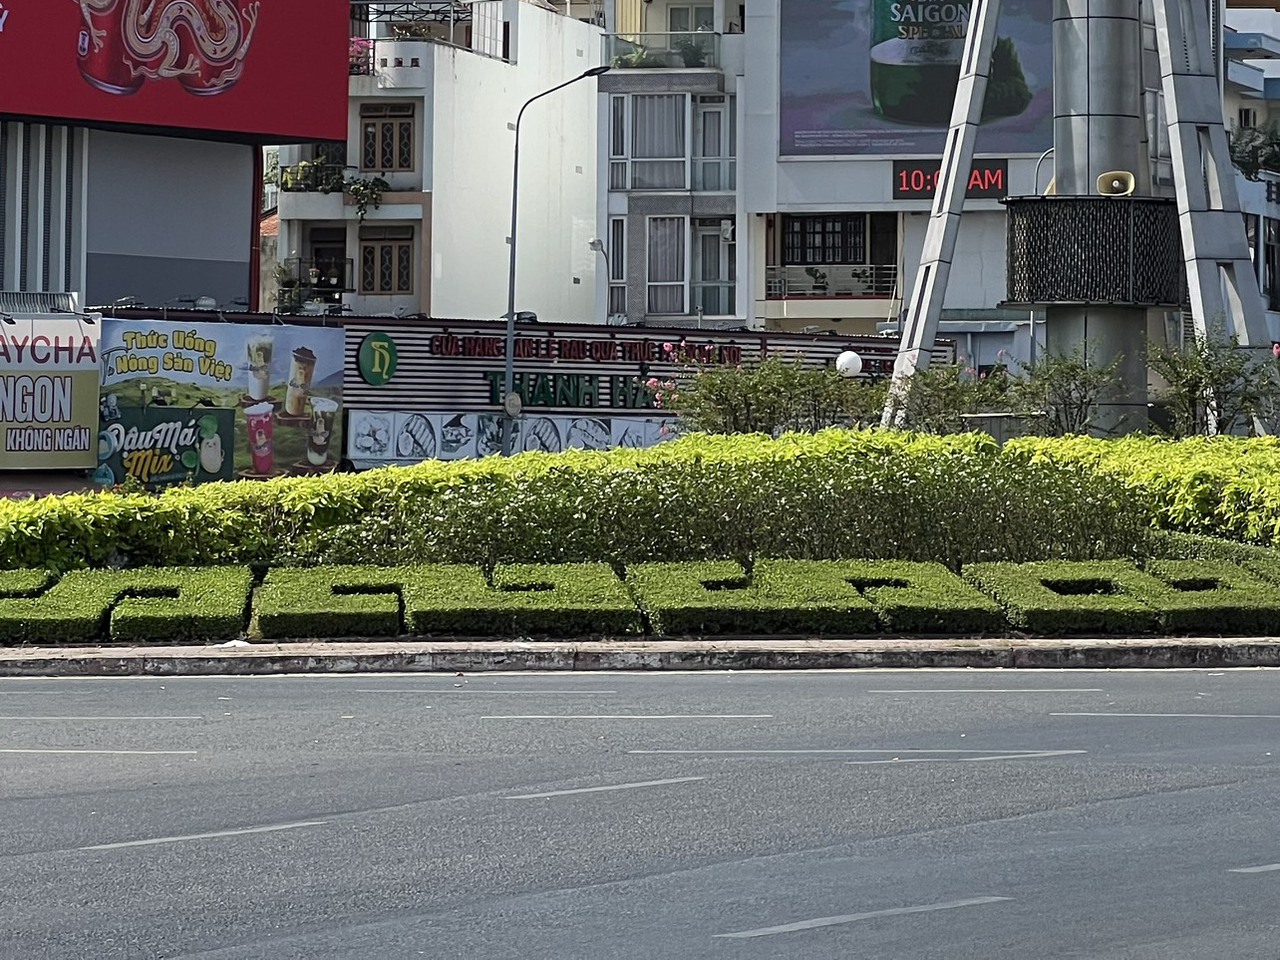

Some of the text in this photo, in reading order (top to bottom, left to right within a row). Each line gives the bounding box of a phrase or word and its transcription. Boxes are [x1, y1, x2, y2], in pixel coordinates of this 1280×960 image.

[890, 3, 970, 23] SAIGON
[899, 169, 1003, 191] 10: AM
[123, 329, 217, 357] Thức Uống
[115, 353, 159, 374] Nông
[198, 355, 233, 382] Việt
[0, 375, 73, 423] NGON
[6, 426, 91, 451] KHÔNG NGÁN
[153, 419, 196, 454] Má
[123, 448, 174, 483] Mix
